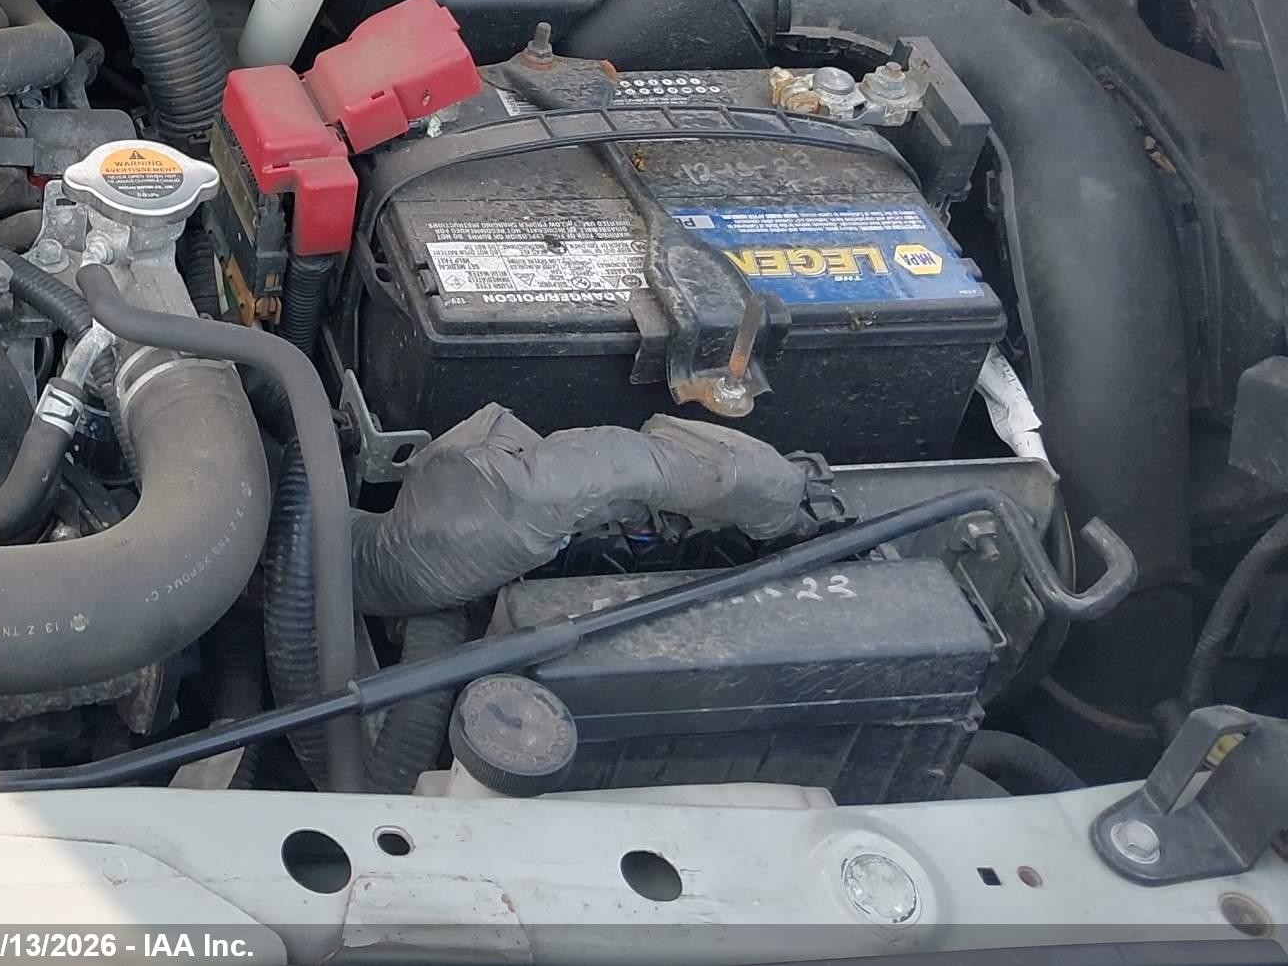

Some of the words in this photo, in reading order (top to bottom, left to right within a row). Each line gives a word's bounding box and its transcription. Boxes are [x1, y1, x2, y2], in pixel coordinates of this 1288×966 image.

[720, 246, 889, 278] LEGEN
[898, 253, 938, 266] NAPA
[483, 293, 616, 303] DANGER/POISON
[27, 625, 35, 635] Z
[45, 622, 59, 634] 13
